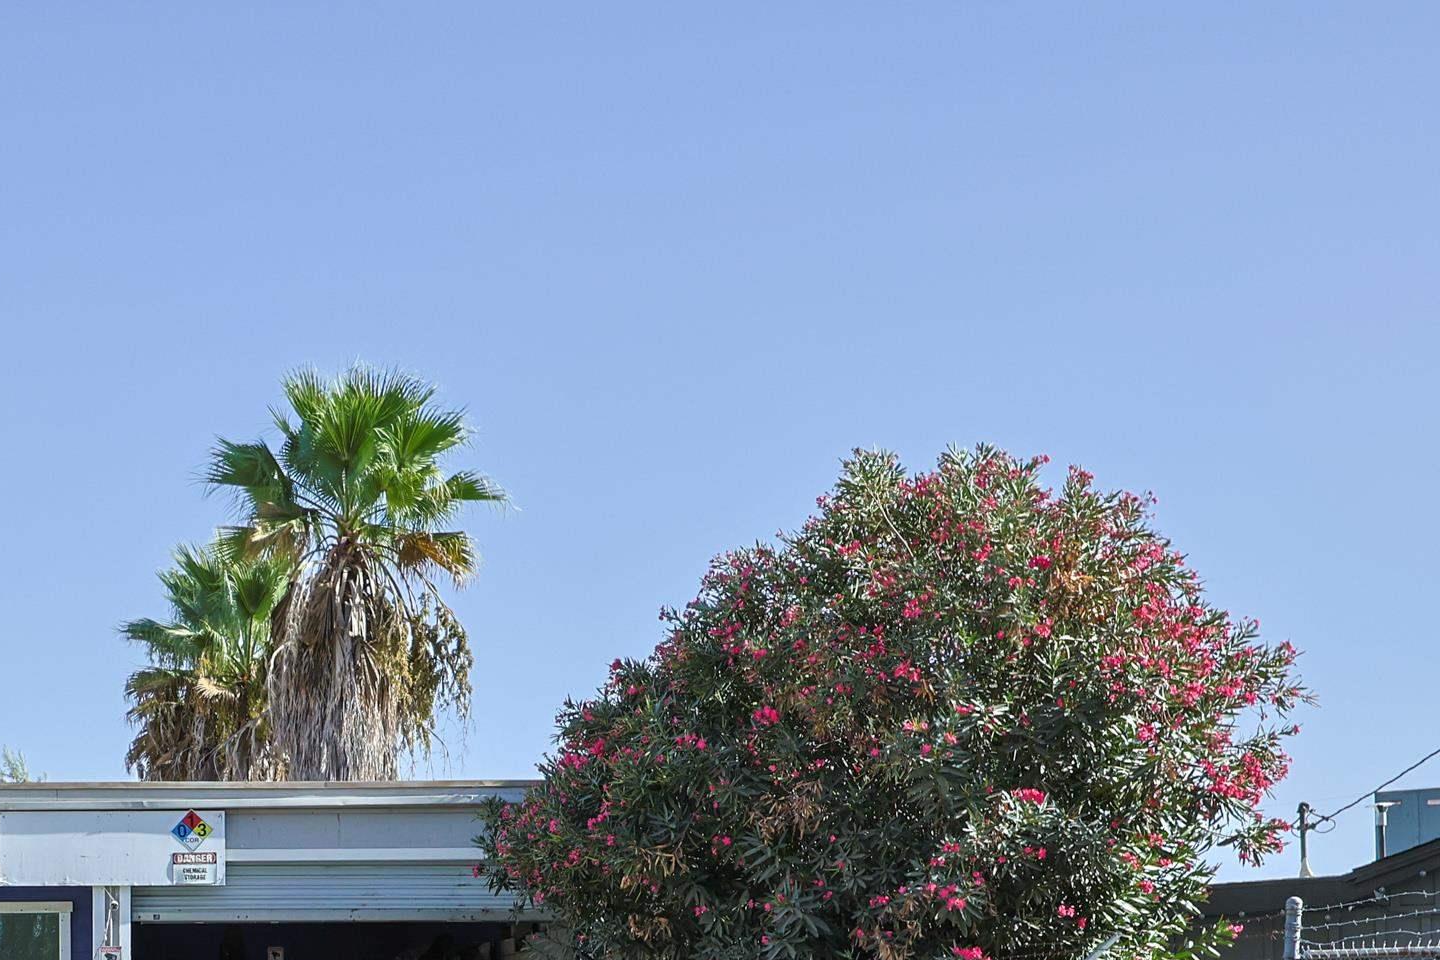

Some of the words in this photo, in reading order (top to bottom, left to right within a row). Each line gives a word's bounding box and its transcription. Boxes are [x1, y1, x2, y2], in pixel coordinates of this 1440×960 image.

[178, 825, 186, 837] 0
[197, 824, 207, 836] 3
[177, 854, 214, 862] DANGER
